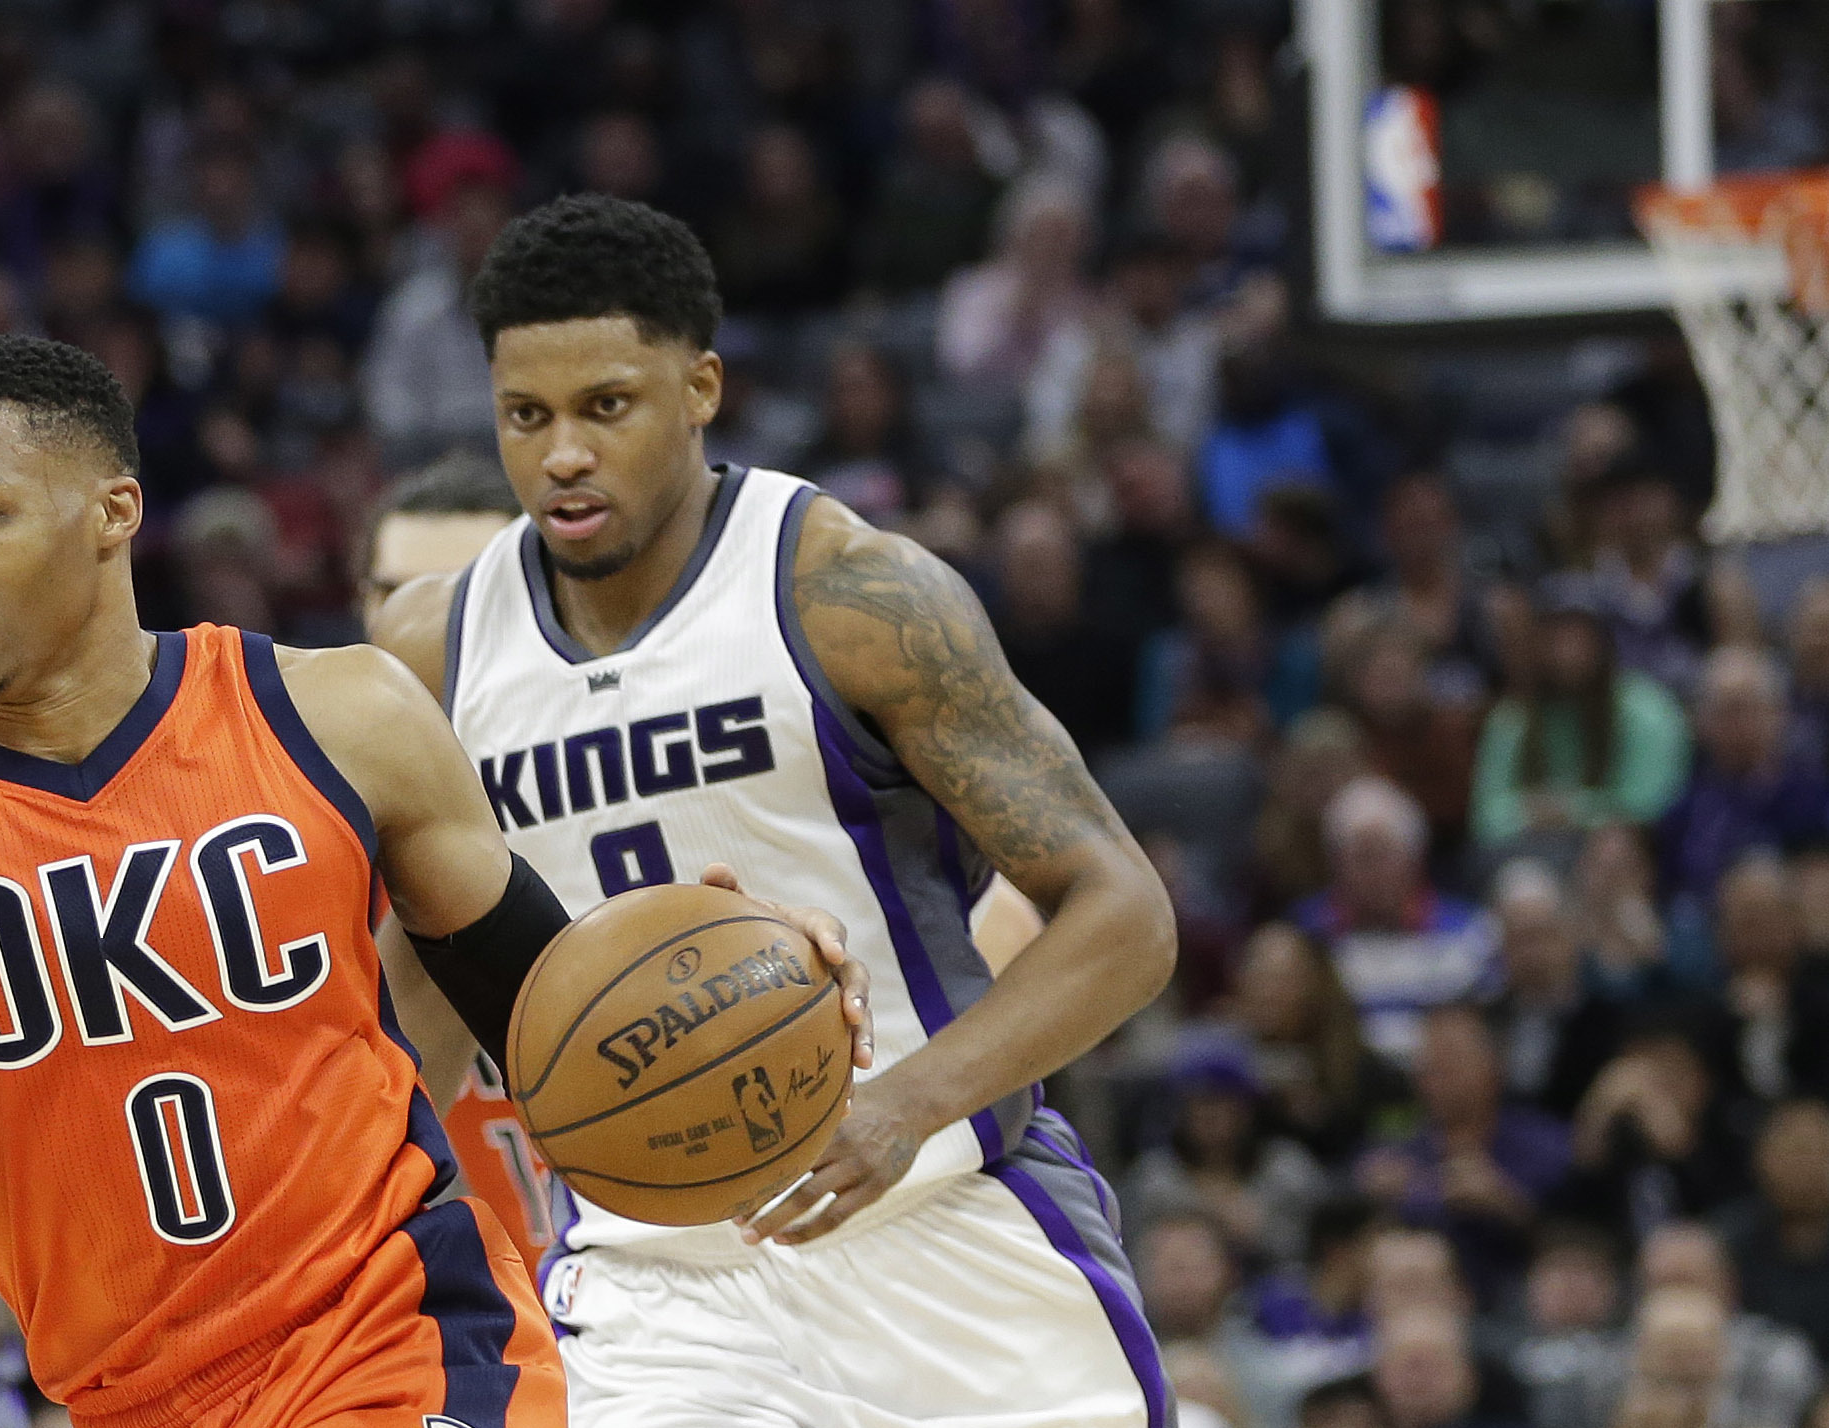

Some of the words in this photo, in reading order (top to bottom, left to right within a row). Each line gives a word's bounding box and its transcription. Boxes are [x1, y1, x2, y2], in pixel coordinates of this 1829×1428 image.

[480, 694, 776, 833] KINGS
[597, 938, 815, 1090] SPALDING
[125, 1071, 236, 1246] 0
